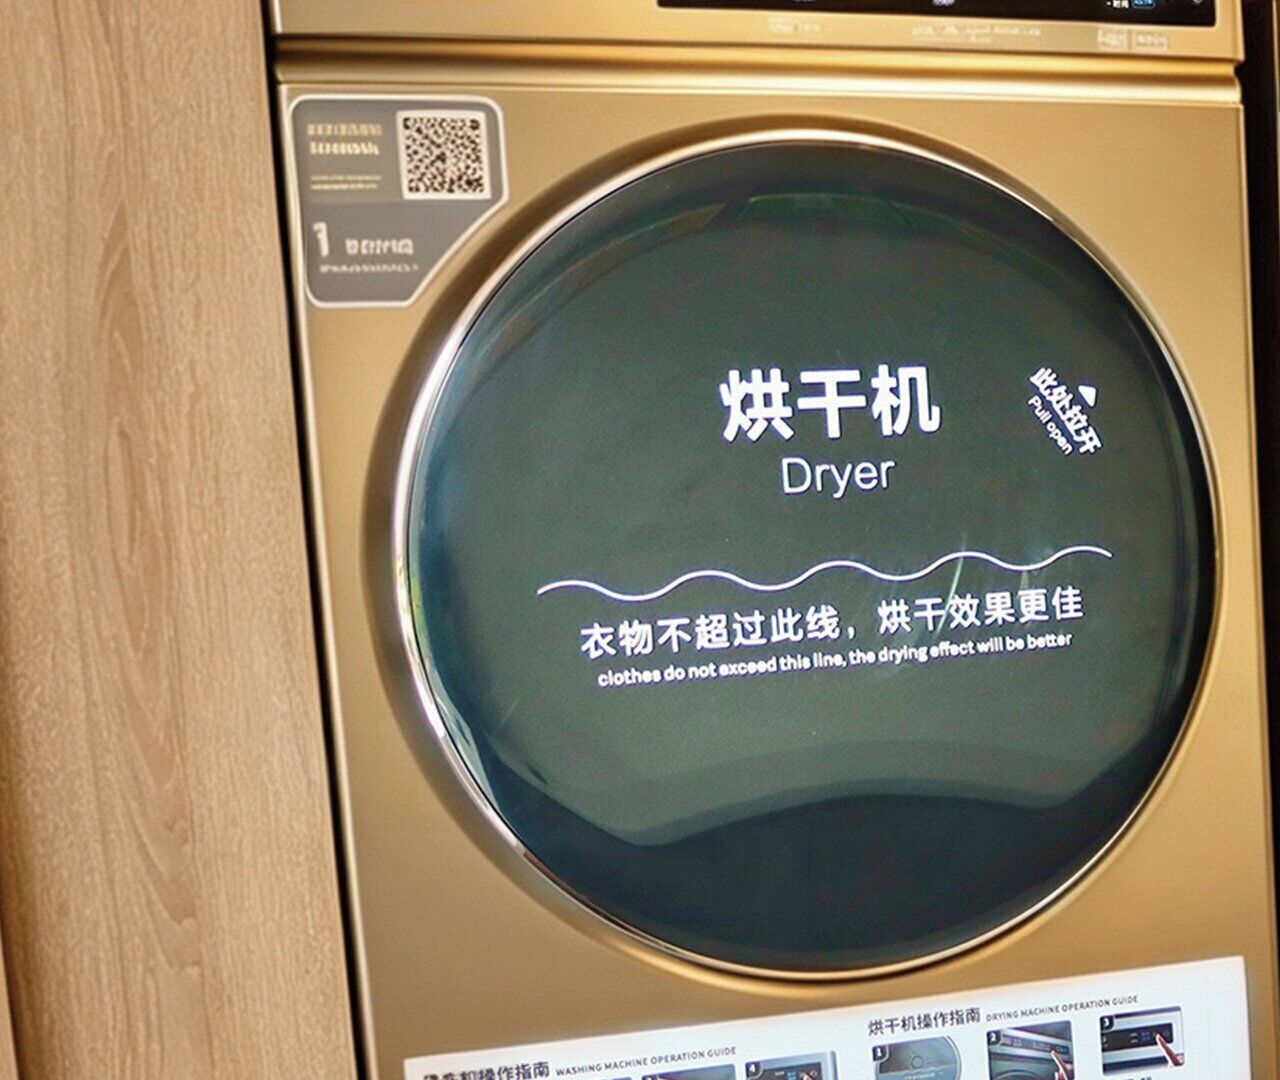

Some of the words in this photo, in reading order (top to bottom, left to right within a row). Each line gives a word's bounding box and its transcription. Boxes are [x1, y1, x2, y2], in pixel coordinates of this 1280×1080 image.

[721, 365, 942, 444] 烘干机
[1027, 395, 1051, 425] Pull
[1046, 422, 1073, 455] open
[1029, 367, 1103, 455] 此处拉开
[782, 457, 896, 499] Dryer
[580, 586, 1084, 660] 衣物不超过此线，烘干效果更佳
[597, 667, 662, 687] clothes
[663, 663, 686, 682] do
[687, 662, 718, 680] not
[718, 655, 777, 677] exceed
[779, 653, 811, 672] this
[812, 651, 847, 668] line,
[848, 648, 876, 666] the
[878, 644, 929, 665] drying
[929, 639, 976, 658] effect
[976, 636, 1004, 654] will
[1005, 635, 1025, 652] be
[1026, 633, 1072, 650] better
[868, 1007, 981, 1036] 烘干机操作指南
[985, 1009, 1019, 1023] DRYING
[1020, 1004, 1060, 1019] MACHINE
[1061, 998, 1111, 1014] OPERATION
[1111, 994, 1138, 1007] GUIDE
[555, 1062, 603, 1077] WASHING
[604, 1056, 648, 1071] MACHINE
[649, 1049, 705, 1065] OPERATION
[706, 1045, 736, 1058] GUIDE
